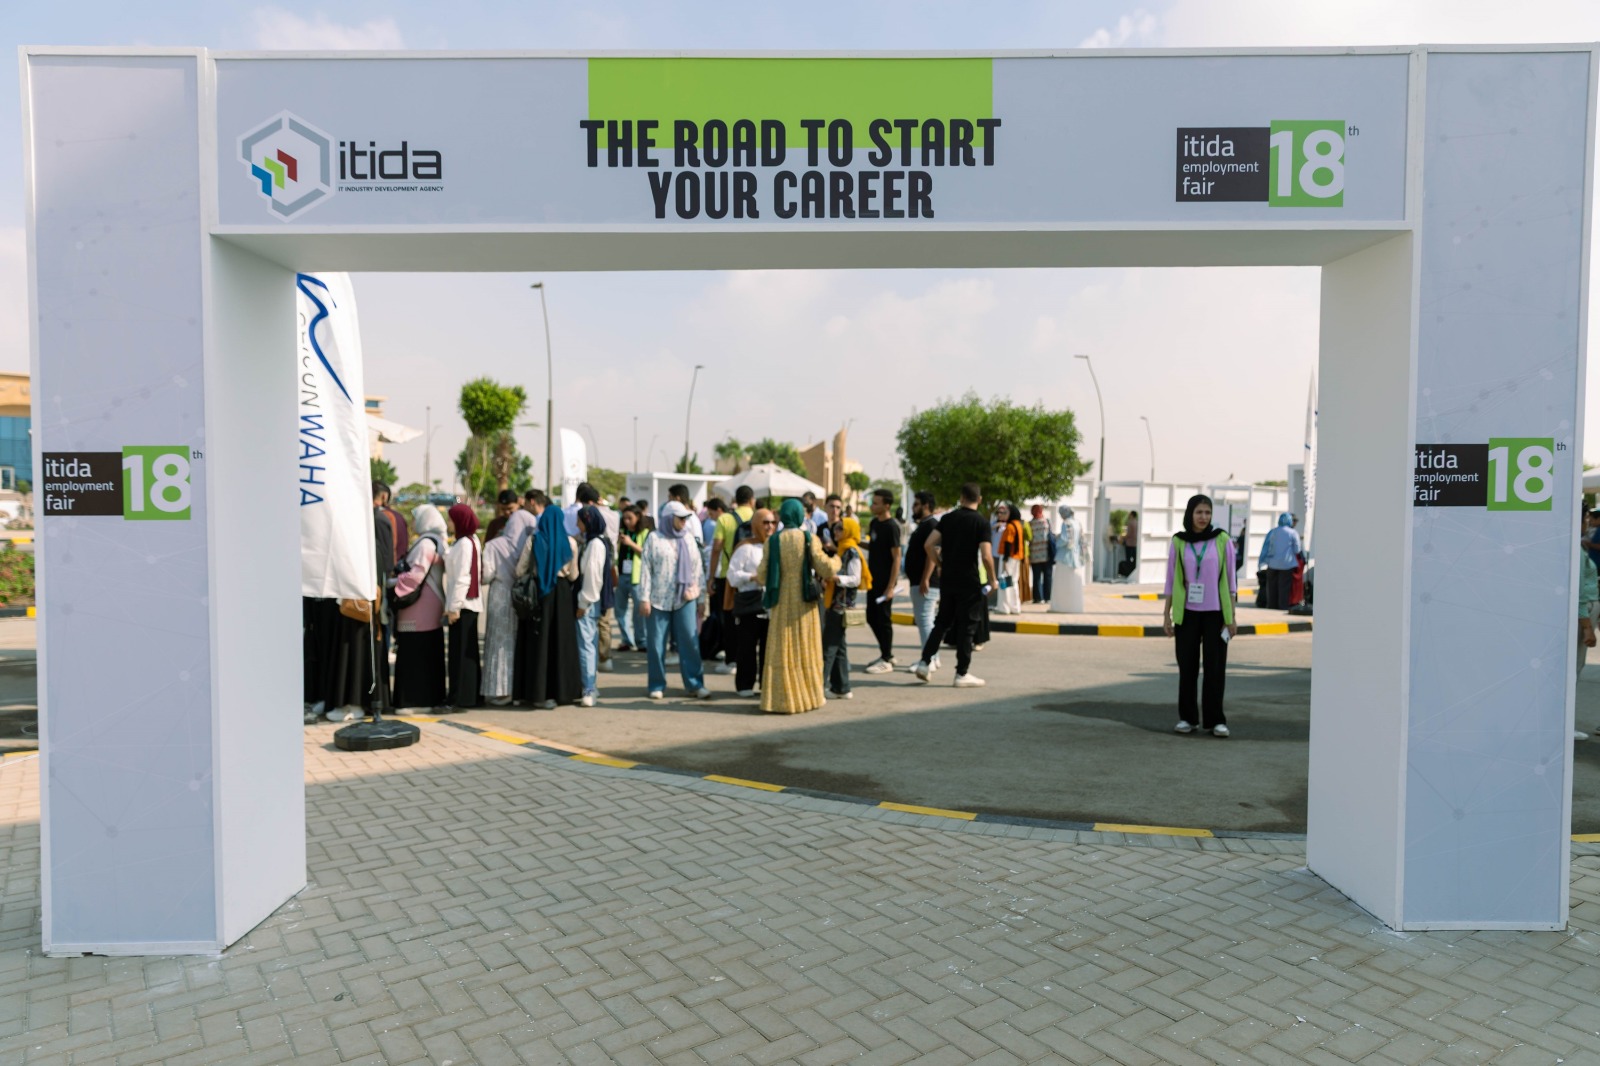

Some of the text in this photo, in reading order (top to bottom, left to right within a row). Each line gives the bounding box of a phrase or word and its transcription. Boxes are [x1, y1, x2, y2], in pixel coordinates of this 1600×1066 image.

[580, 118, 1002, 168] THE ROAD TO START
[1183, 134, 1235, 157] itida
[339, 141, 442, 179] itida
[1182, 161, 1259, 175] employment
[648, 170, 935, 219] YOUR CAREER
[1182, 177, 1215, 195] fair
[45, 458, 92, 478] itida
[300, 414, 326, 506] WAHA
[1414, 449, 1458, 469] itida
[45, 481, 114, 493] employment
[1413, 472, 1479, 484] employment
[45, 494, 75, 510] fair
[1413, 485, 1441, 501] fair
